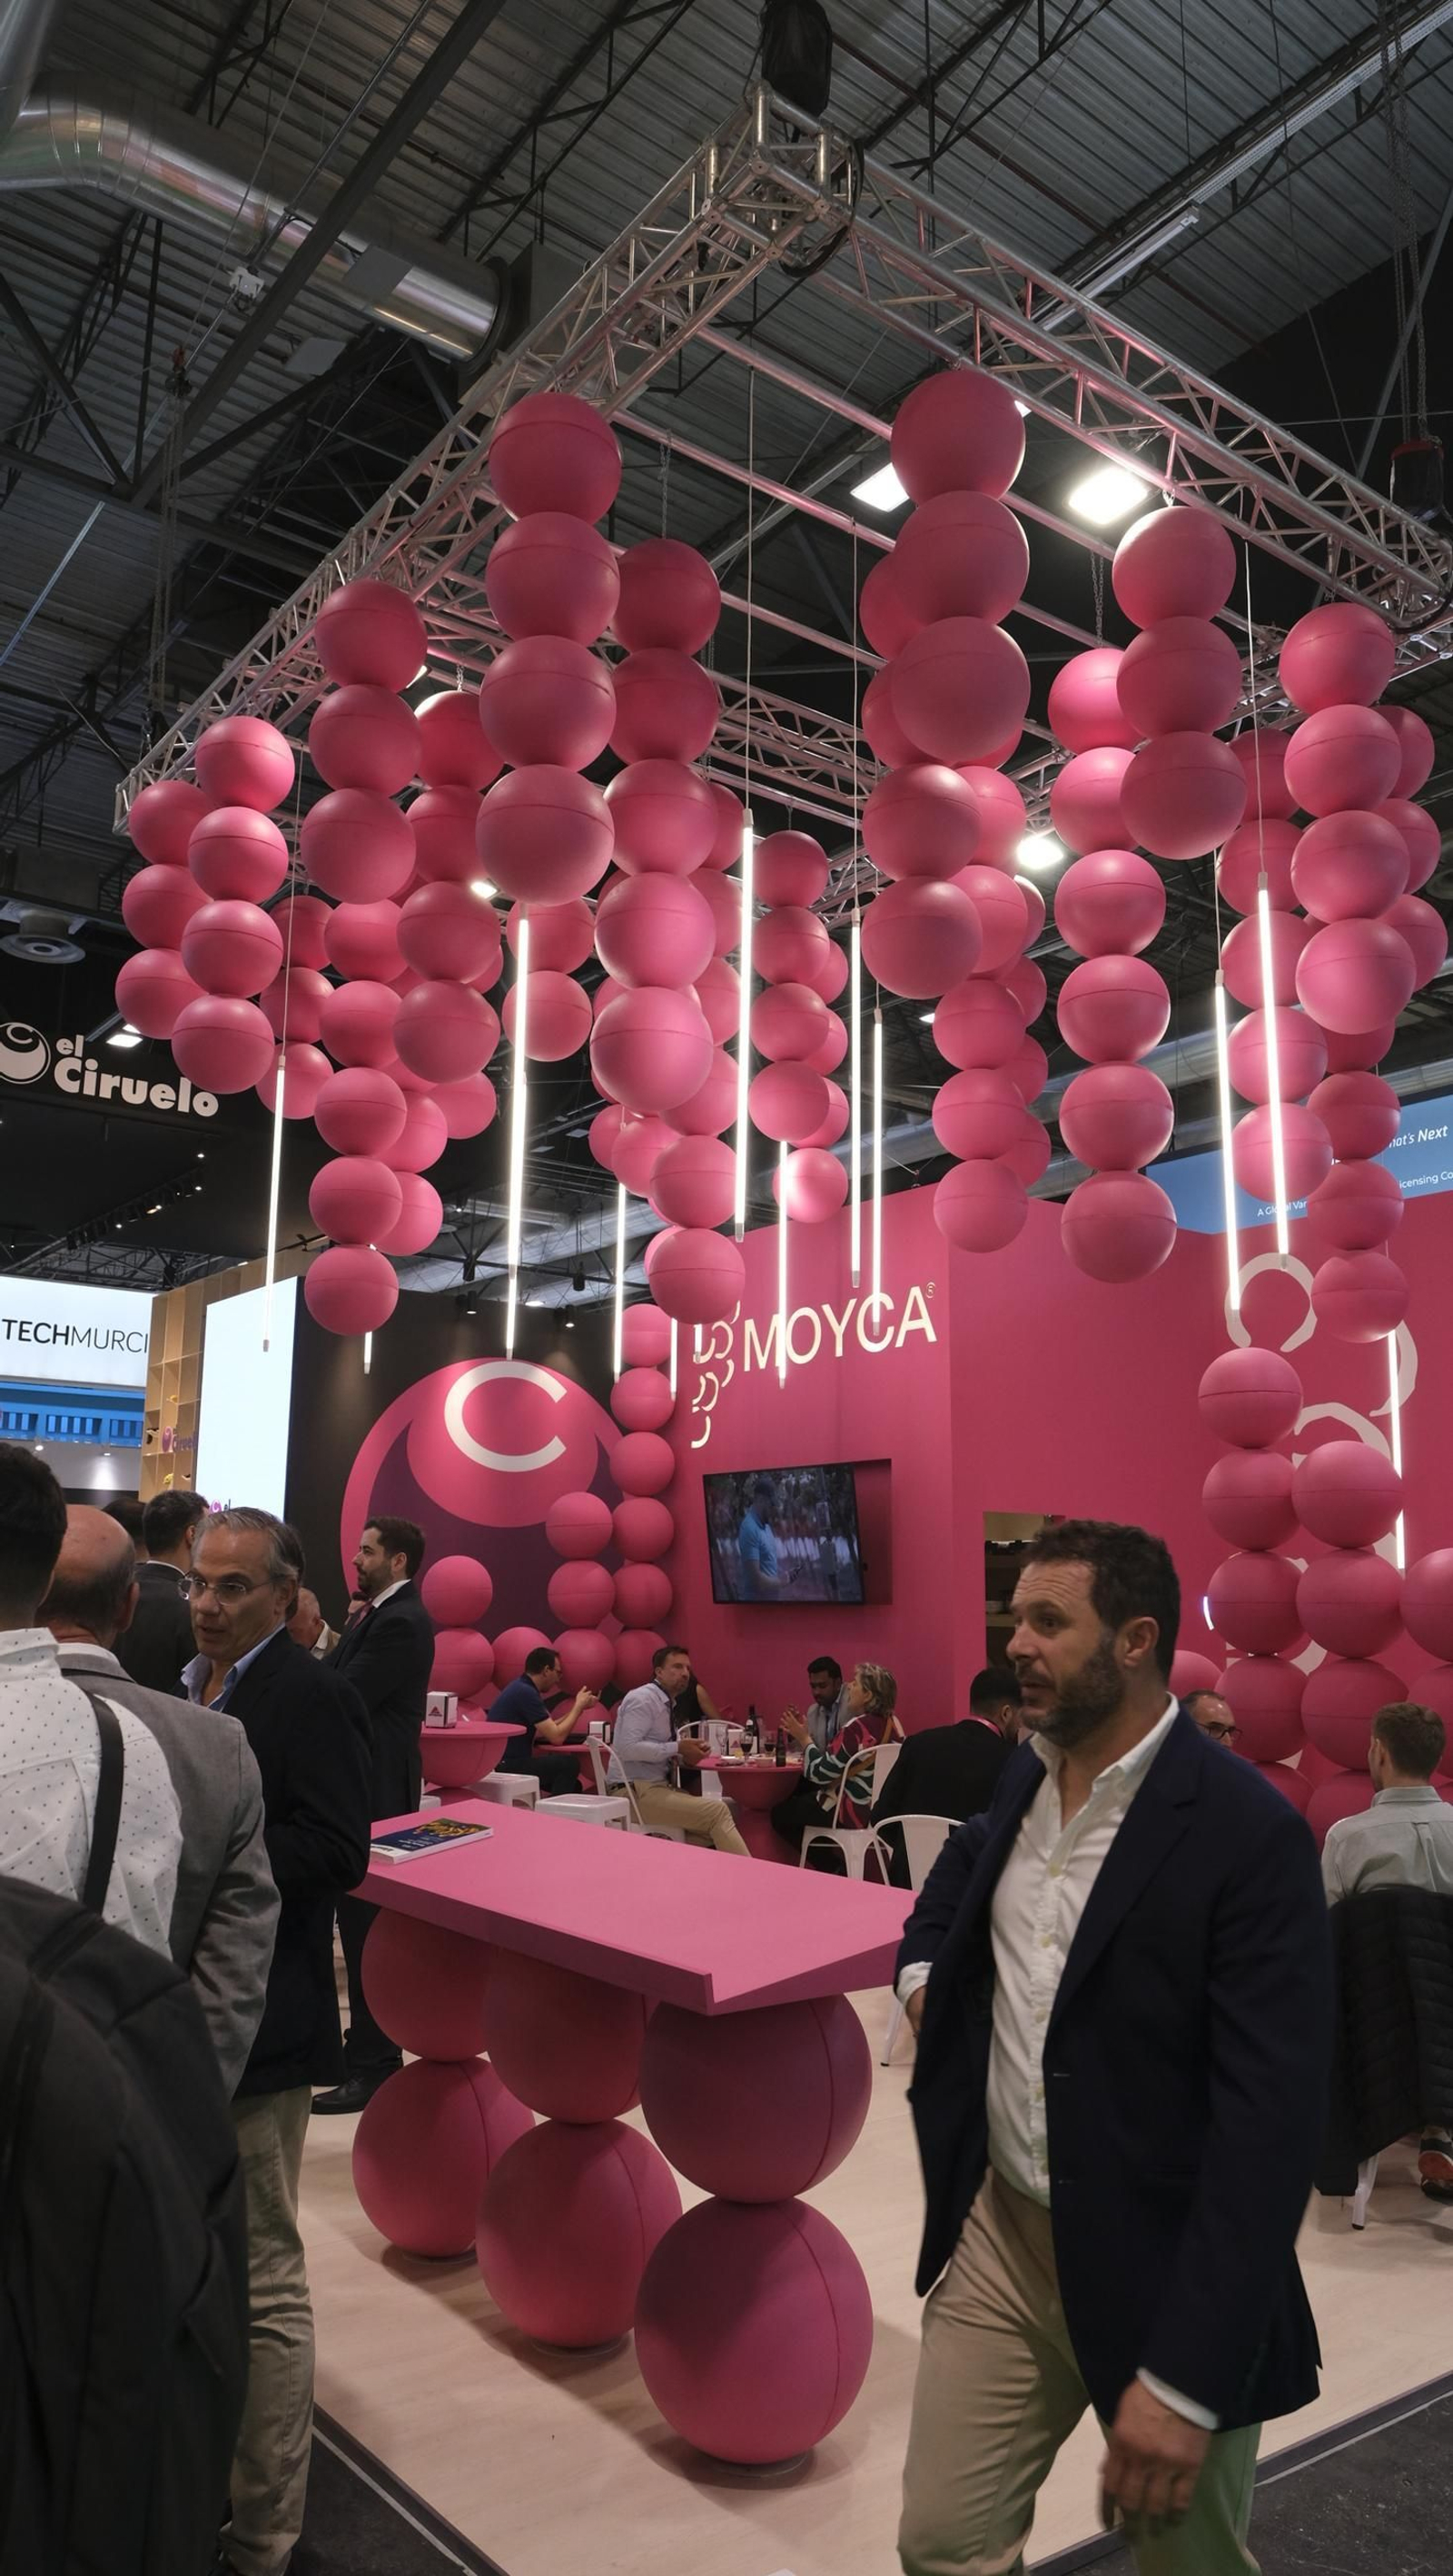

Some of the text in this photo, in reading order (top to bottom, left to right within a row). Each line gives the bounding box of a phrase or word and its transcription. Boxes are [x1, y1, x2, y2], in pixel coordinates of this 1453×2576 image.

[55, 1035, 84, 1057] el
[54, 1056, 219, 1117] Ciruelo
[1418, 1125, 1448, 1143] Next
[1257, 1208, 1264, 1217] A
[1292, 1200, 1308, 1210] Var
[2, 1318, 149, 1353] TECHMURCI
